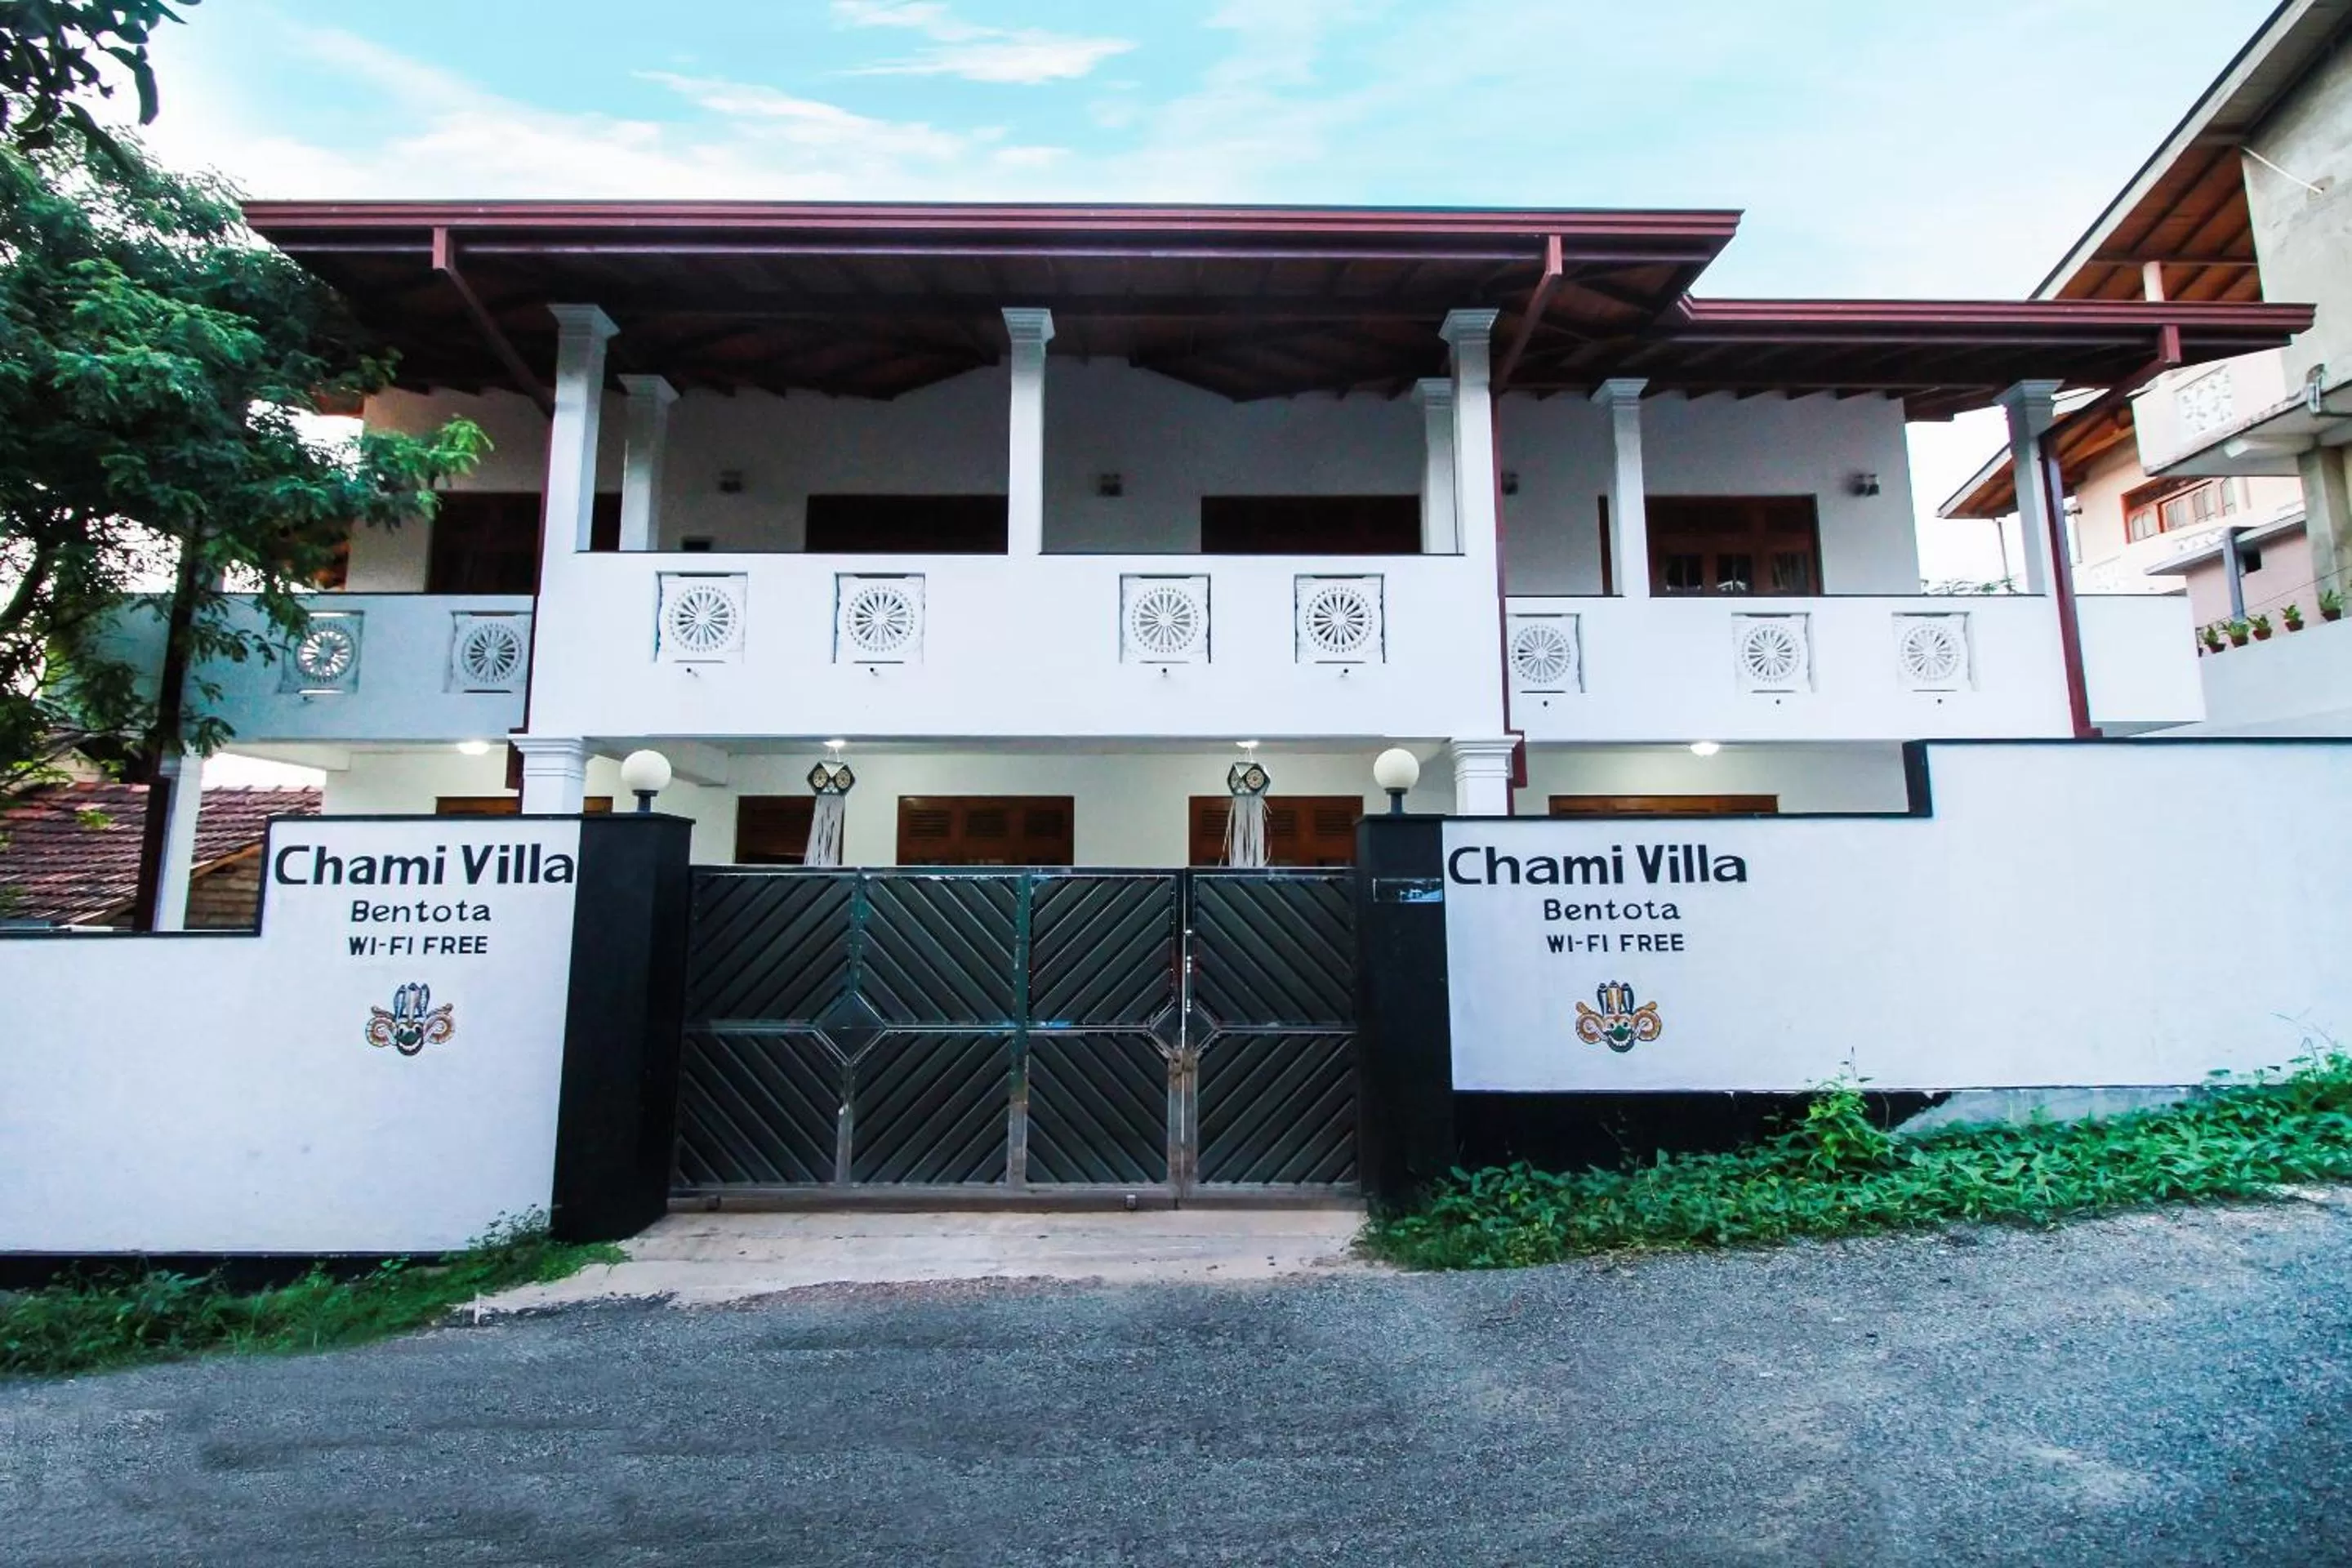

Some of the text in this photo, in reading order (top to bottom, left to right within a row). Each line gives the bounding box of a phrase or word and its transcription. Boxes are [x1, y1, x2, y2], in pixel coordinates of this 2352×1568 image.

[274, 843, 573, 885] Chami Villa
[1448, 844, 1748, 885] Chami Villa
[350, 900, 492, 923] Bentota
[1544, 898, 1682, 921] Bentota
[349, 935, 488, 956] WI-FI FREE
[1546, 933, 1685, 954] WI-FI FREE
